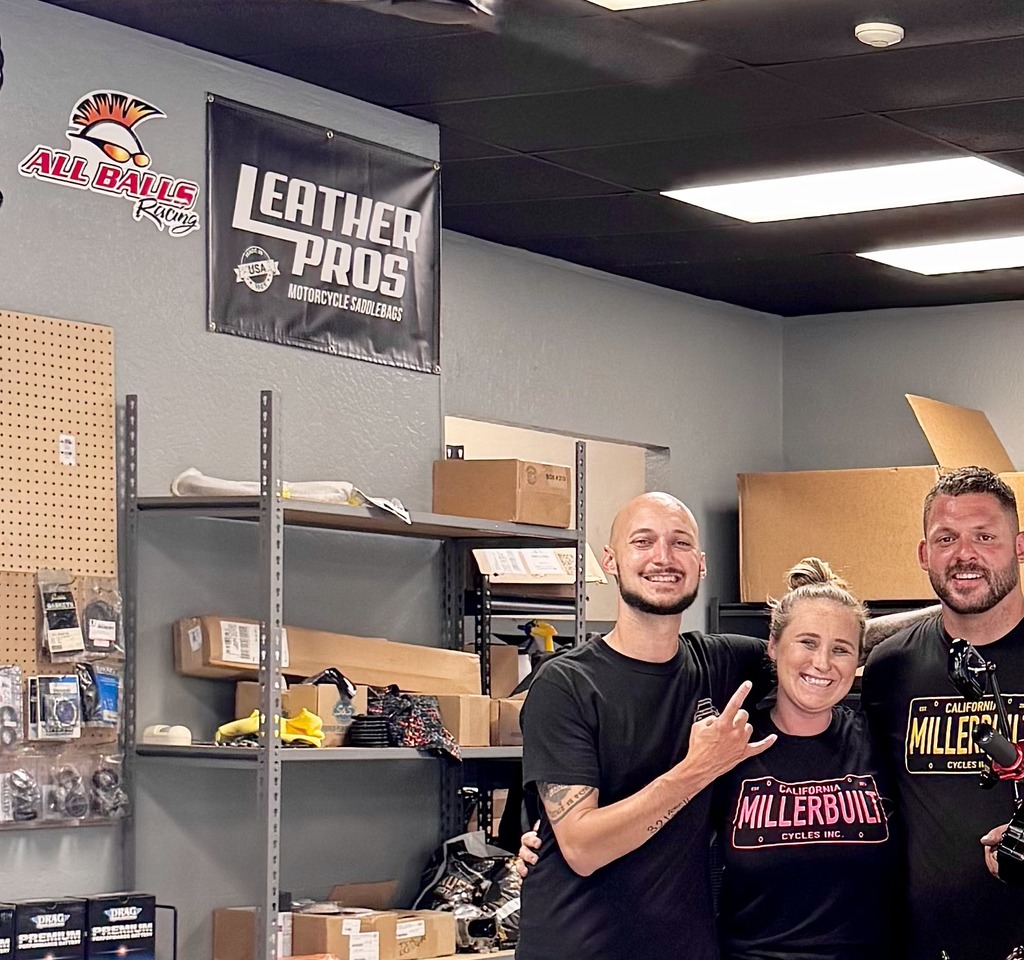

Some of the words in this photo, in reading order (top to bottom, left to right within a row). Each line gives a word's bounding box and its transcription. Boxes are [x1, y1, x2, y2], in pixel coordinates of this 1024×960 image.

[23, 149, 89, 185] ALL
[93, 163, 199, 208] BALLS
[136, 198, 198, 234] Racing
[232, 164, 421, 253] LEATHER
[248, 263, 266, 274] USA
[291, 233, 409, 298] PROS
[288, 283, 350, 310] MOTORCYCLE
[350, 297, 403, 322] SADDLEBAGS
[947, 761, 977, 769] CYCLES
[778, 783, 841, 796] CALIFORNIA
[738, 790, 881, 829] MILLERBUILT
[781, 831, 821, 840] CYCLES
[824, 831, 845, 839] INC.
[18, 930, 81, 944] PREMIUM
[92, 922, 153, 937] PREMIUM
